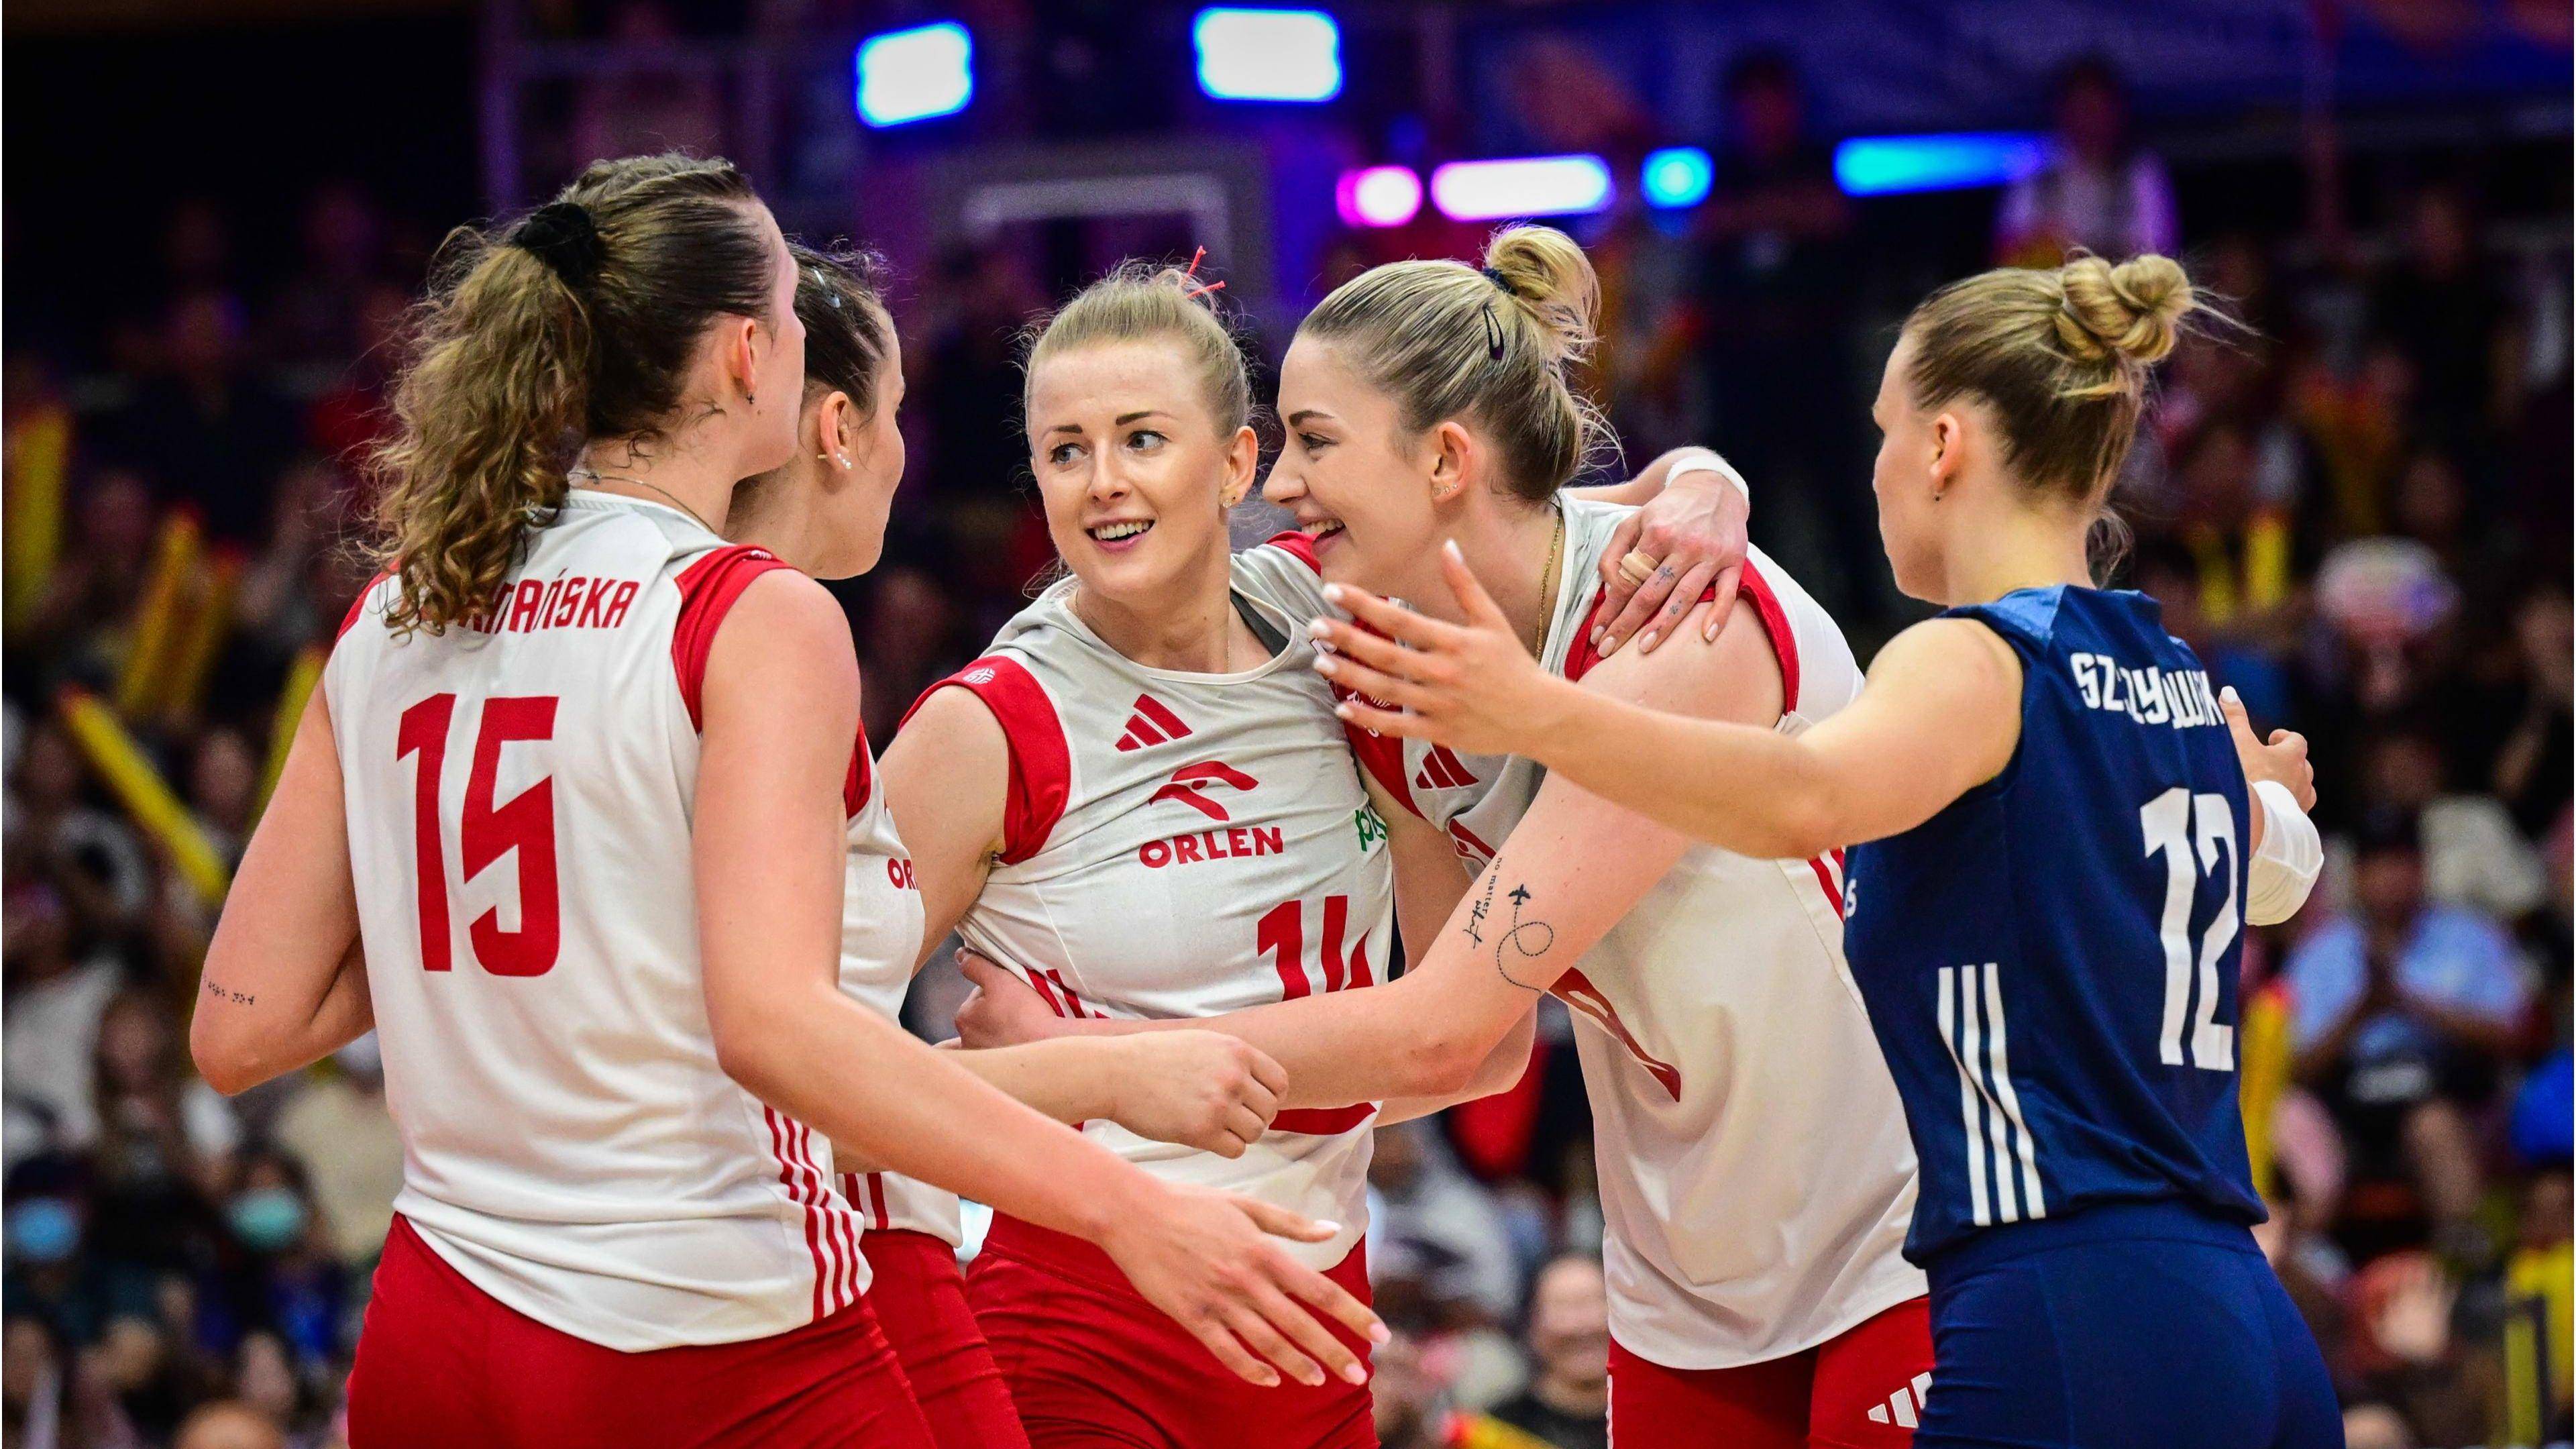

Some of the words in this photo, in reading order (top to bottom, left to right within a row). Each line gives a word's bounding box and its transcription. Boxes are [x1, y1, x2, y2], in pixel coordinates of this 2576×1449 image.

[396, 692, 561, 977] 15
[1139, 826, 1283, 869] ORLEN
[887, 857, 918, 890] OR
[1495, 857, 1503, 871] no
[1482, 875, 1497, 914] matter
[1462, 900, 1485, 950] what
[2140, 787, 2239, 1072] 12
